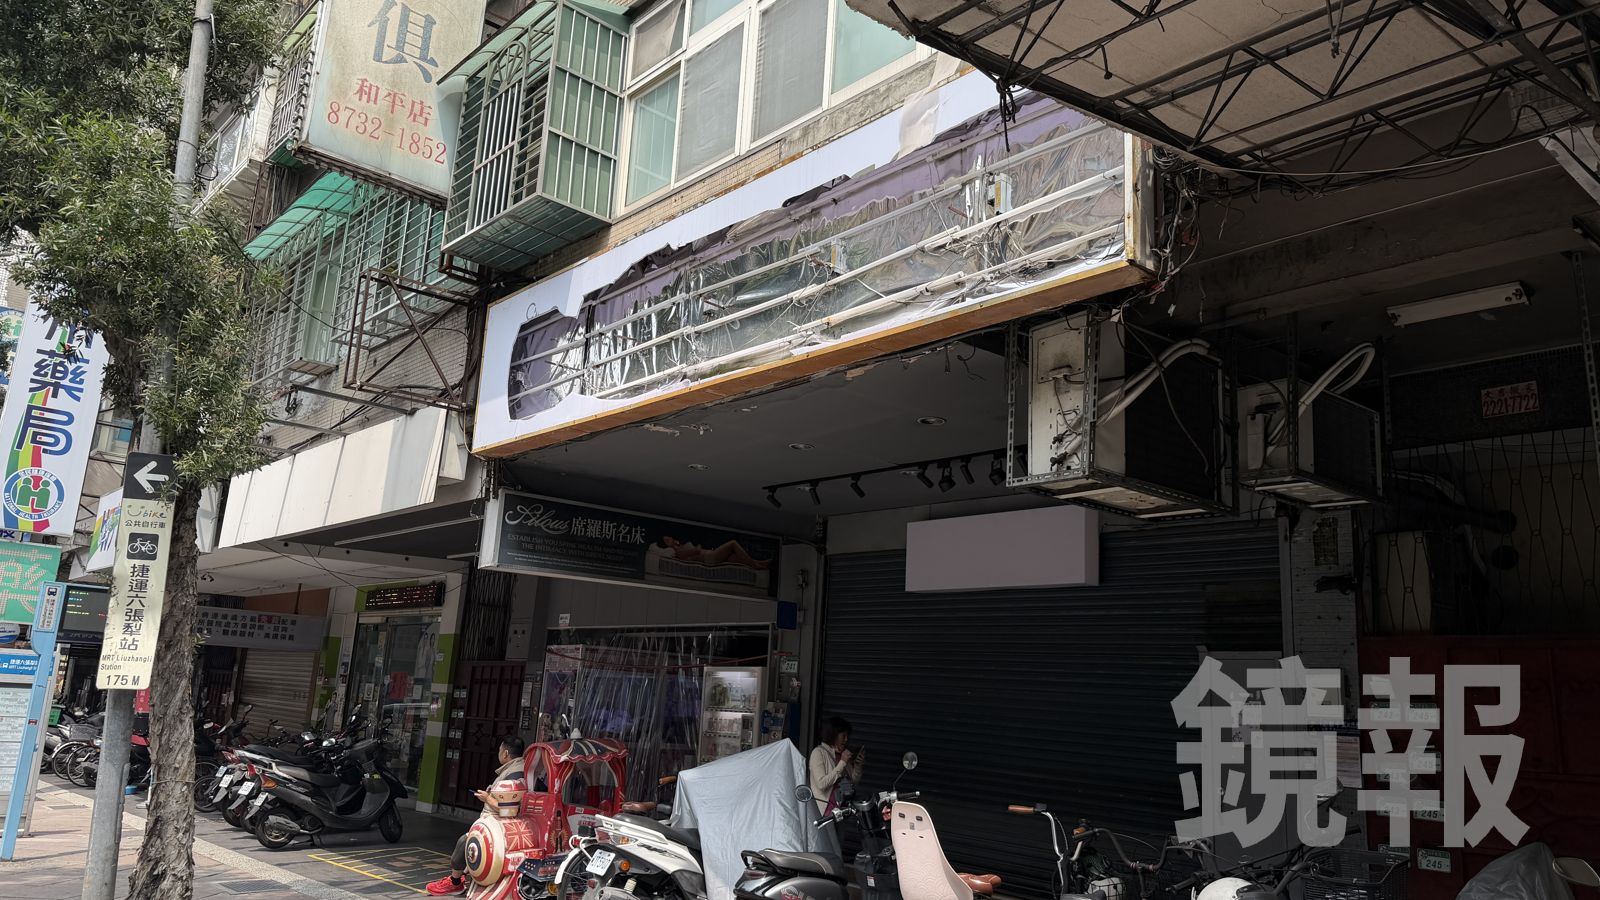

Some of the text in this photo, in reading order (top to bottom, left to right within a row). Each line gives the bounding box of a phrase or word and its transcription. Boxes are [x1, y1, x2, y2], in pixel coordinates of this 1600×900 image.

[367, 0, 440, 84] 俱
[353, 77, 433, 128] 和平店
[326, 100, 447, 166] 8732-1852
[124, 519, 166, 529] 公共自行車
[569, 516, 646, 545] 席羅斯名床
[521, 542, 534, 551] THE
[118, 563, 151, 651] 捷運六張犁站
[102, 654, 153, 664] MRT Liuzhangli
[100, 663, 122, 671] Station
[106, 674, 140, 686] 175 M
[1421, 810, 1438, 819] 245
[1426, 860, 1442, 869] 245
